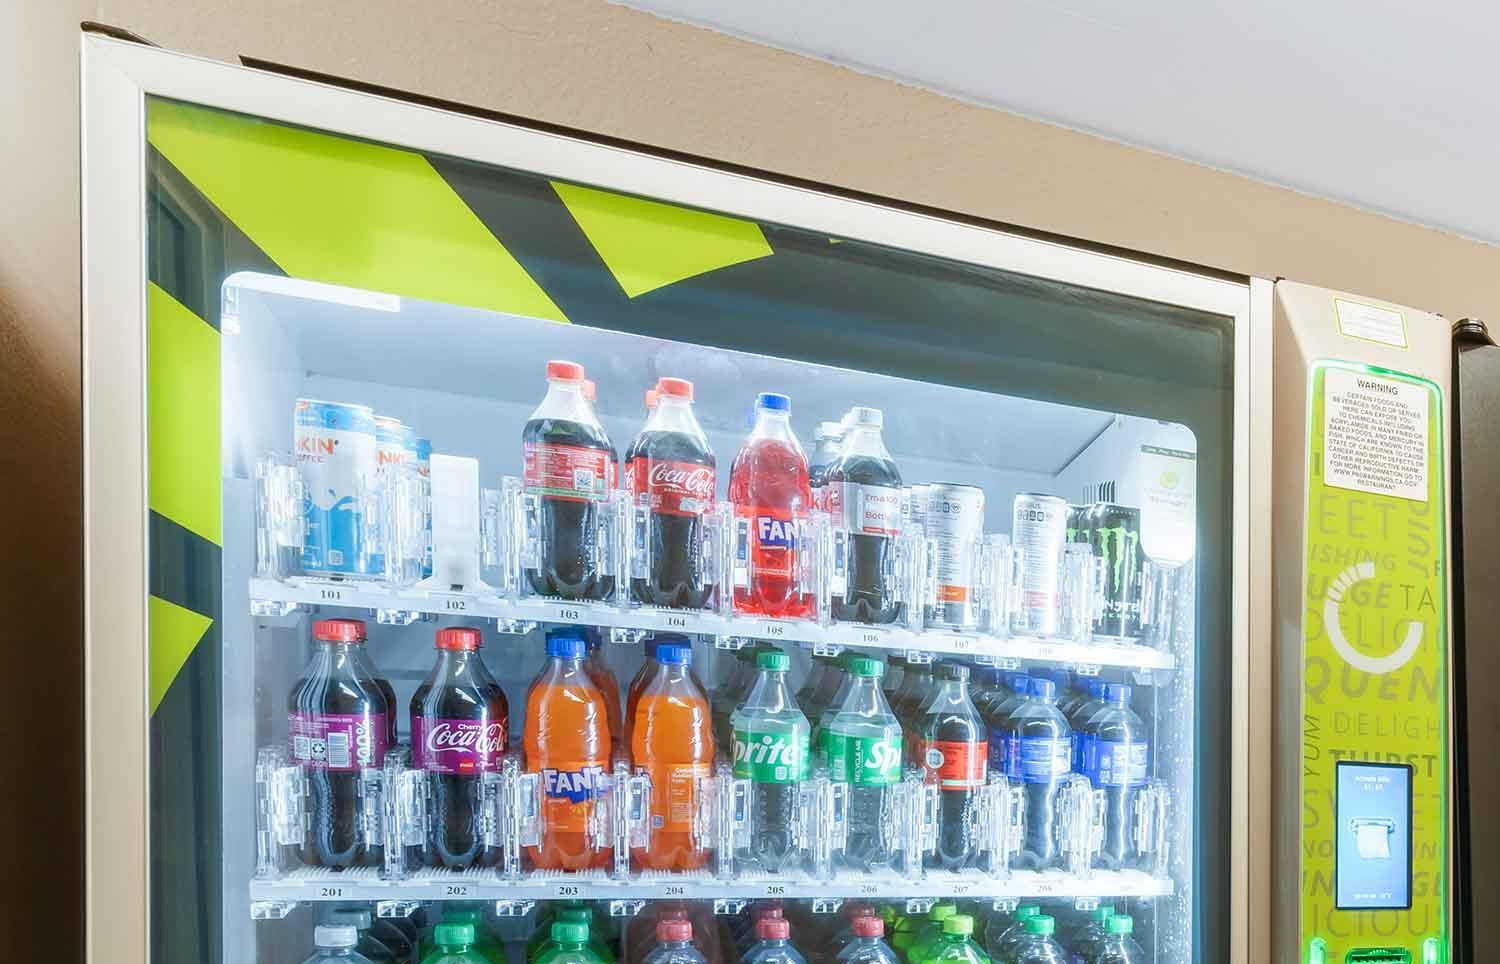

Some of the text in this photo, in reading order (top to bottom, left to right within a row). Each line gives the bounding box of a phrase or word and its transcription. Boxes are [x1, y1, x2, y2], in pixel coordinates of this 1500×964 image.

[1357, 378, 1398, 395] WARNING
[758, 516, 808, 548] FANT
[321, 590, 341, 600] 101
[446, 601, 466, 611] 102
[560, 610, 578, 620] 103
[667, 618, 686, 628] 104
[767, 626, 783, 636] 105
[863, 634, 879, 643] 106
[543, 768, 606, 804] FANT
[322, 888, 343, 898] 201
[447, 887, 467, 897] 202
[559, 887, 579, 896] 203
[666, 887, 684, 896] 204
[767, 886, 785, 896] 205
[862, 885, 878, 895] 206
[954, 885, 969, 895] 207
